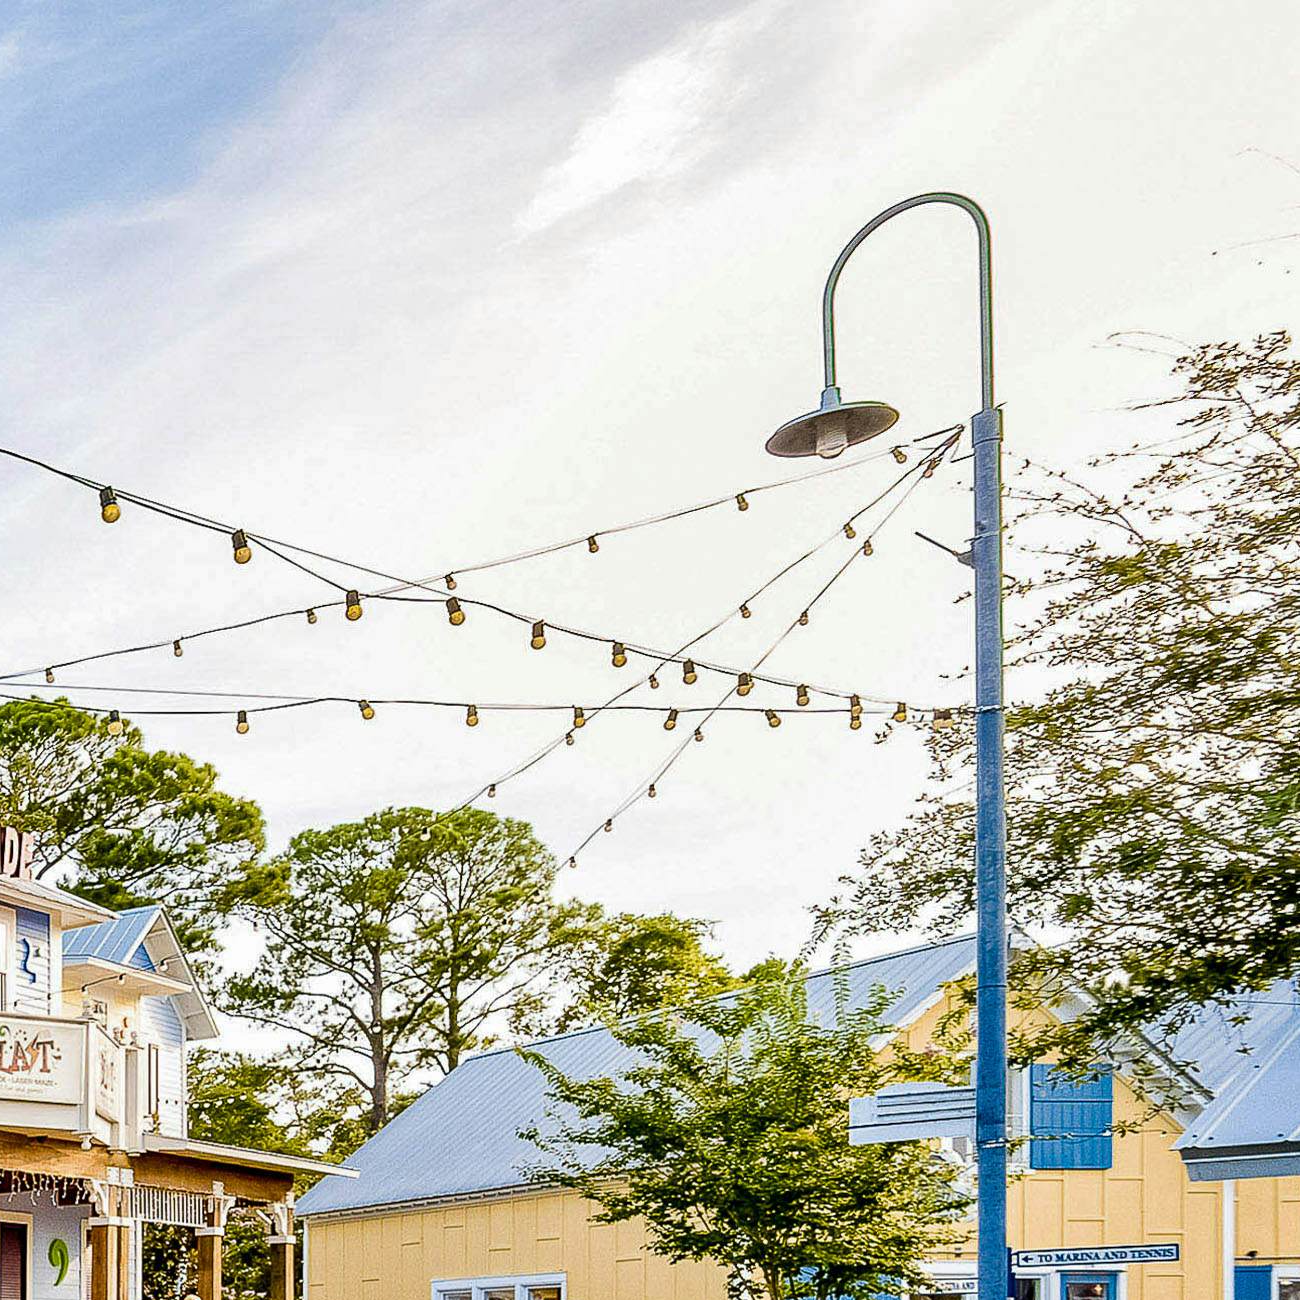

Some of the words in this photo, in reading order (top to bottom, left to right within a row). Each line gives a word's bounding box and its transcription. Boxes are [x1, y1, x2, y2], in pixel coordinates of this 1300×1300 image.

[1038, 1254, 1053, 1263] TO
[1055, 1251, 1100, 1263] MARINA
[1101, 1250, 1128, 1260] AND
[1130, 1248, 1175, 1259] TENNIS
